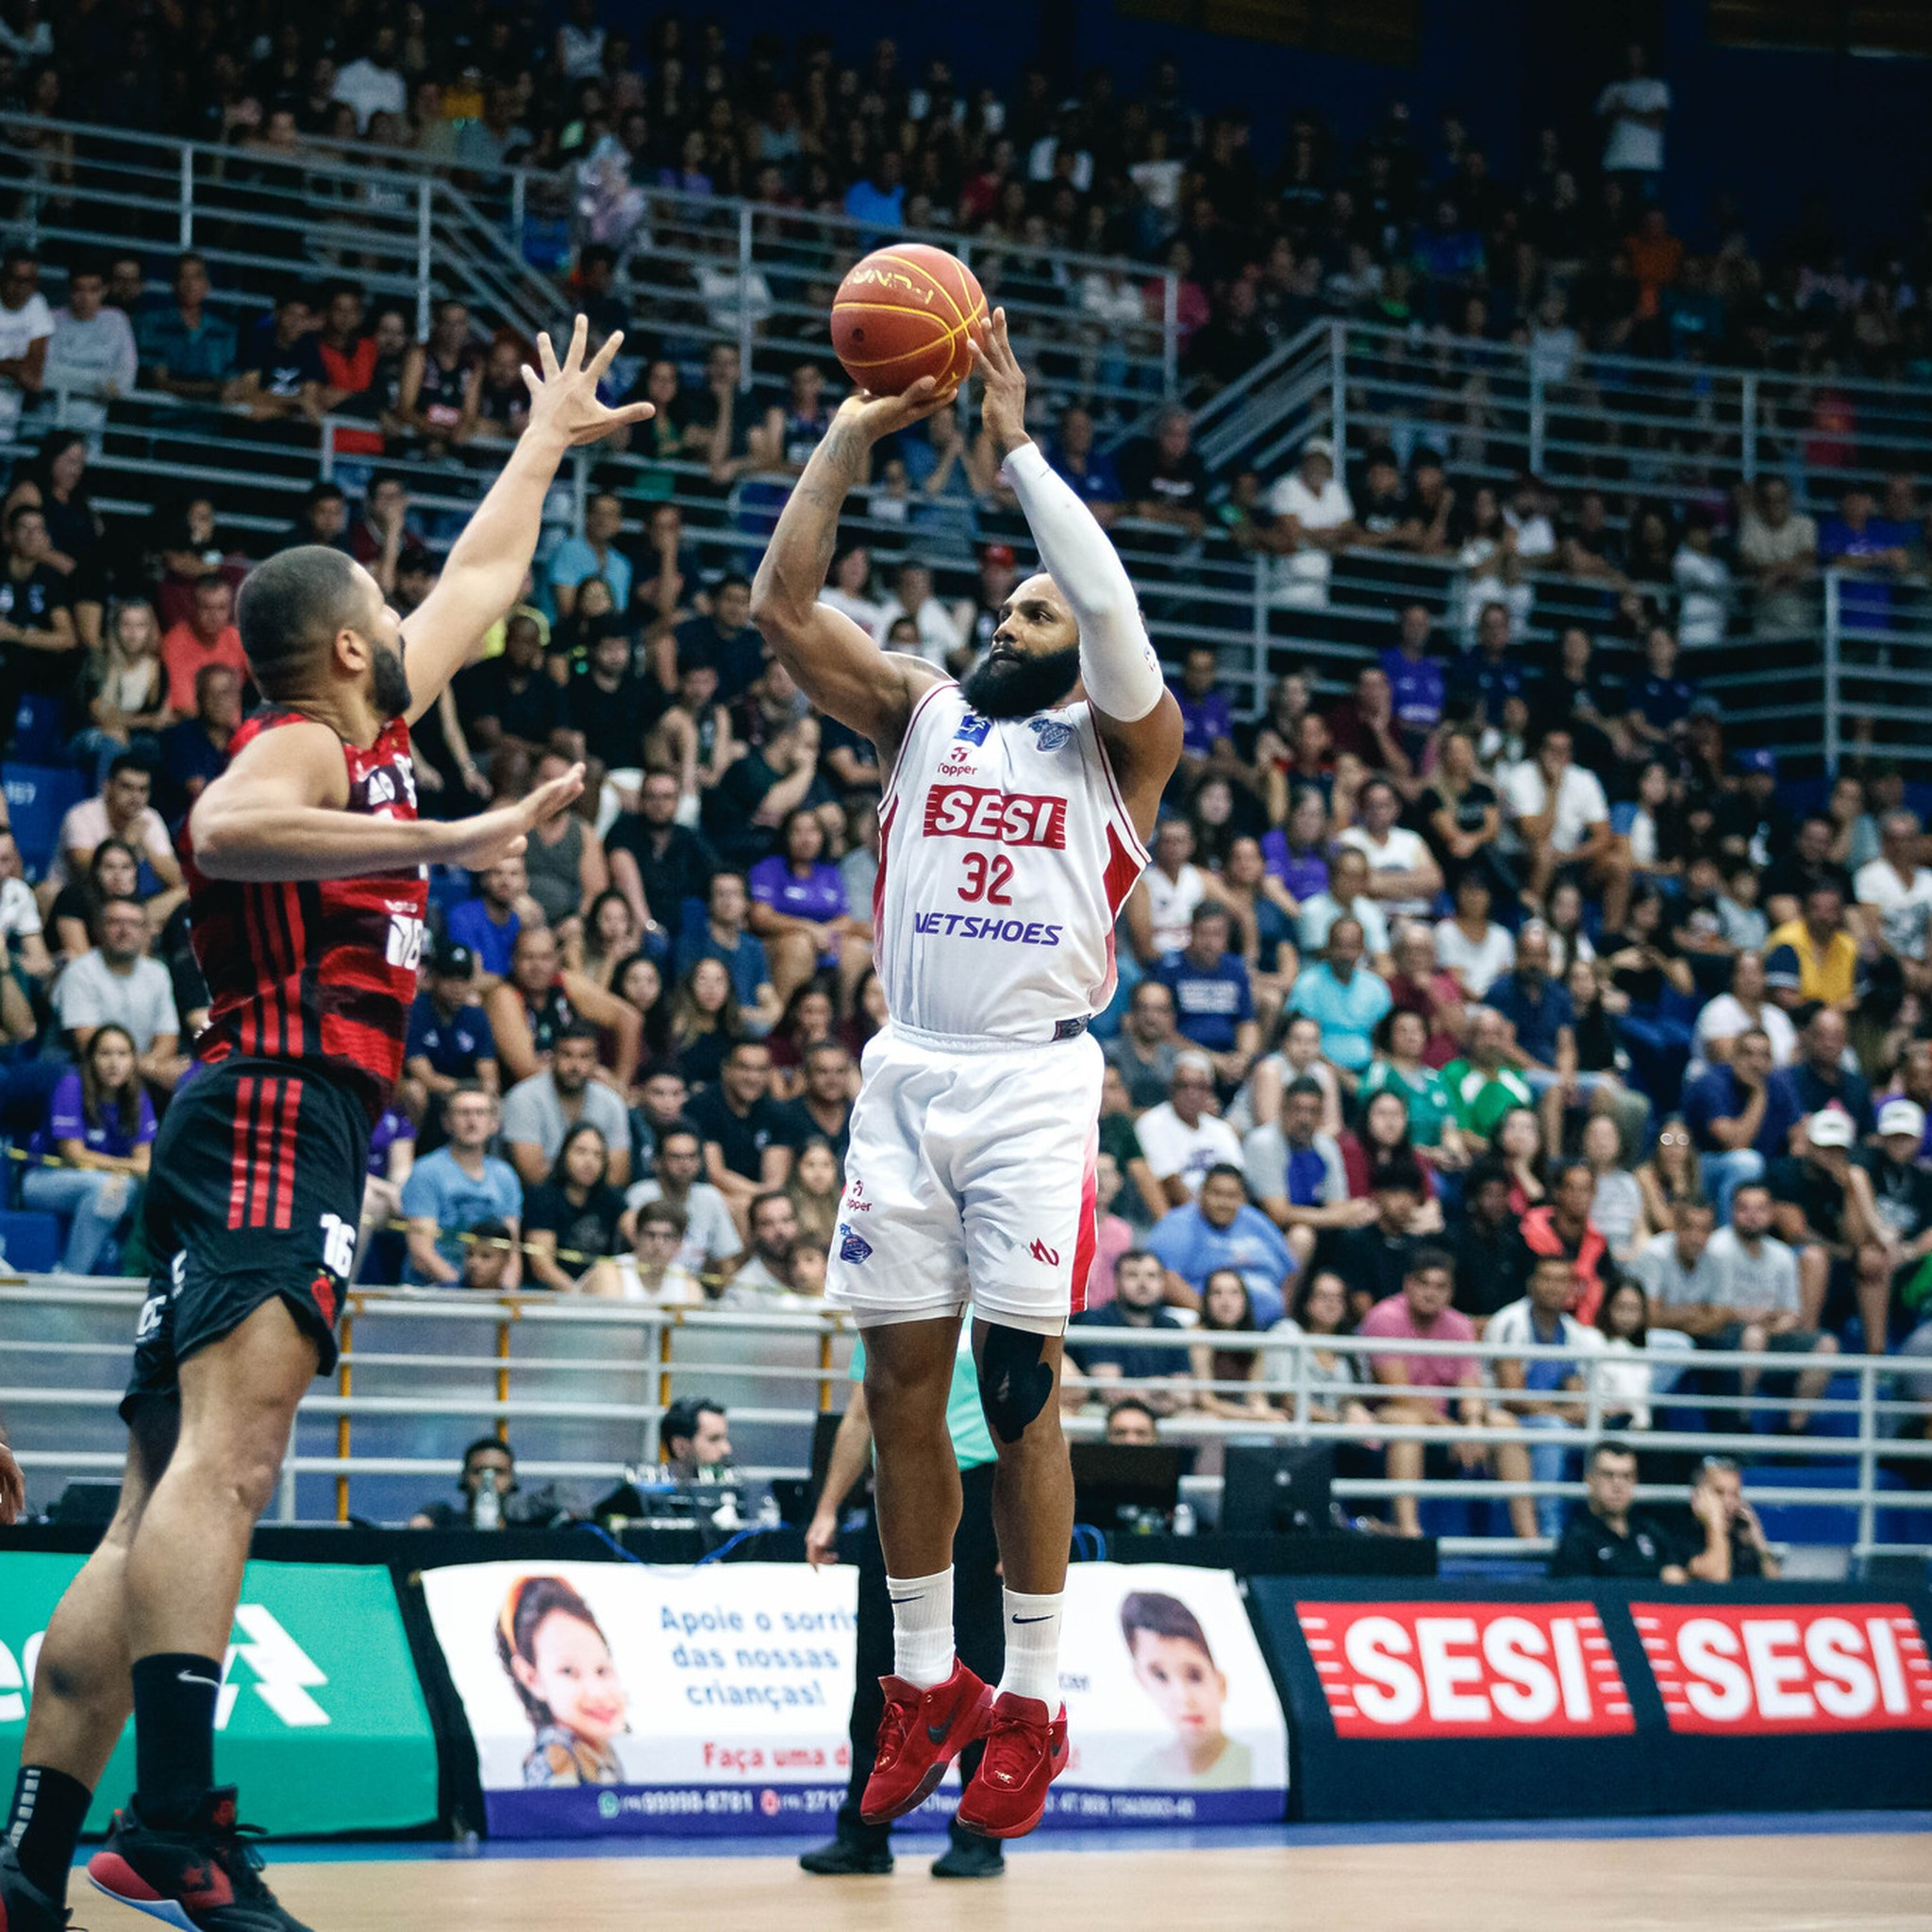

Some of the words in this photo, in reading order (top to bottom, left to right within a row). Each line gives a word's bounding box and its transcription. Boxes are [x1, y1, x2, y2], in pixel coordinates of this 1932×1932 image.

[935, 790, 1054, 842] SESI
[958, 852, 1015, 906] 32
[320, 1213, 356, 1277] 16
[661, 1605, 743, 1638] Apoie
[756, 1612, 772, 1632] o
[781, 1605, 858, 1633] sorri
[673, 1643, 725, 1669] das
[736, 1649, 839, 1669] nossas
[1344, 1616, 1592, 1724] SESI
[1676, 1617, 1910, 1722] SESI
[686, 1679, 825, 1712] crianças!
[704, 1741, 765, 1775] Faça
[774, 1748, 826, 1768] uma
